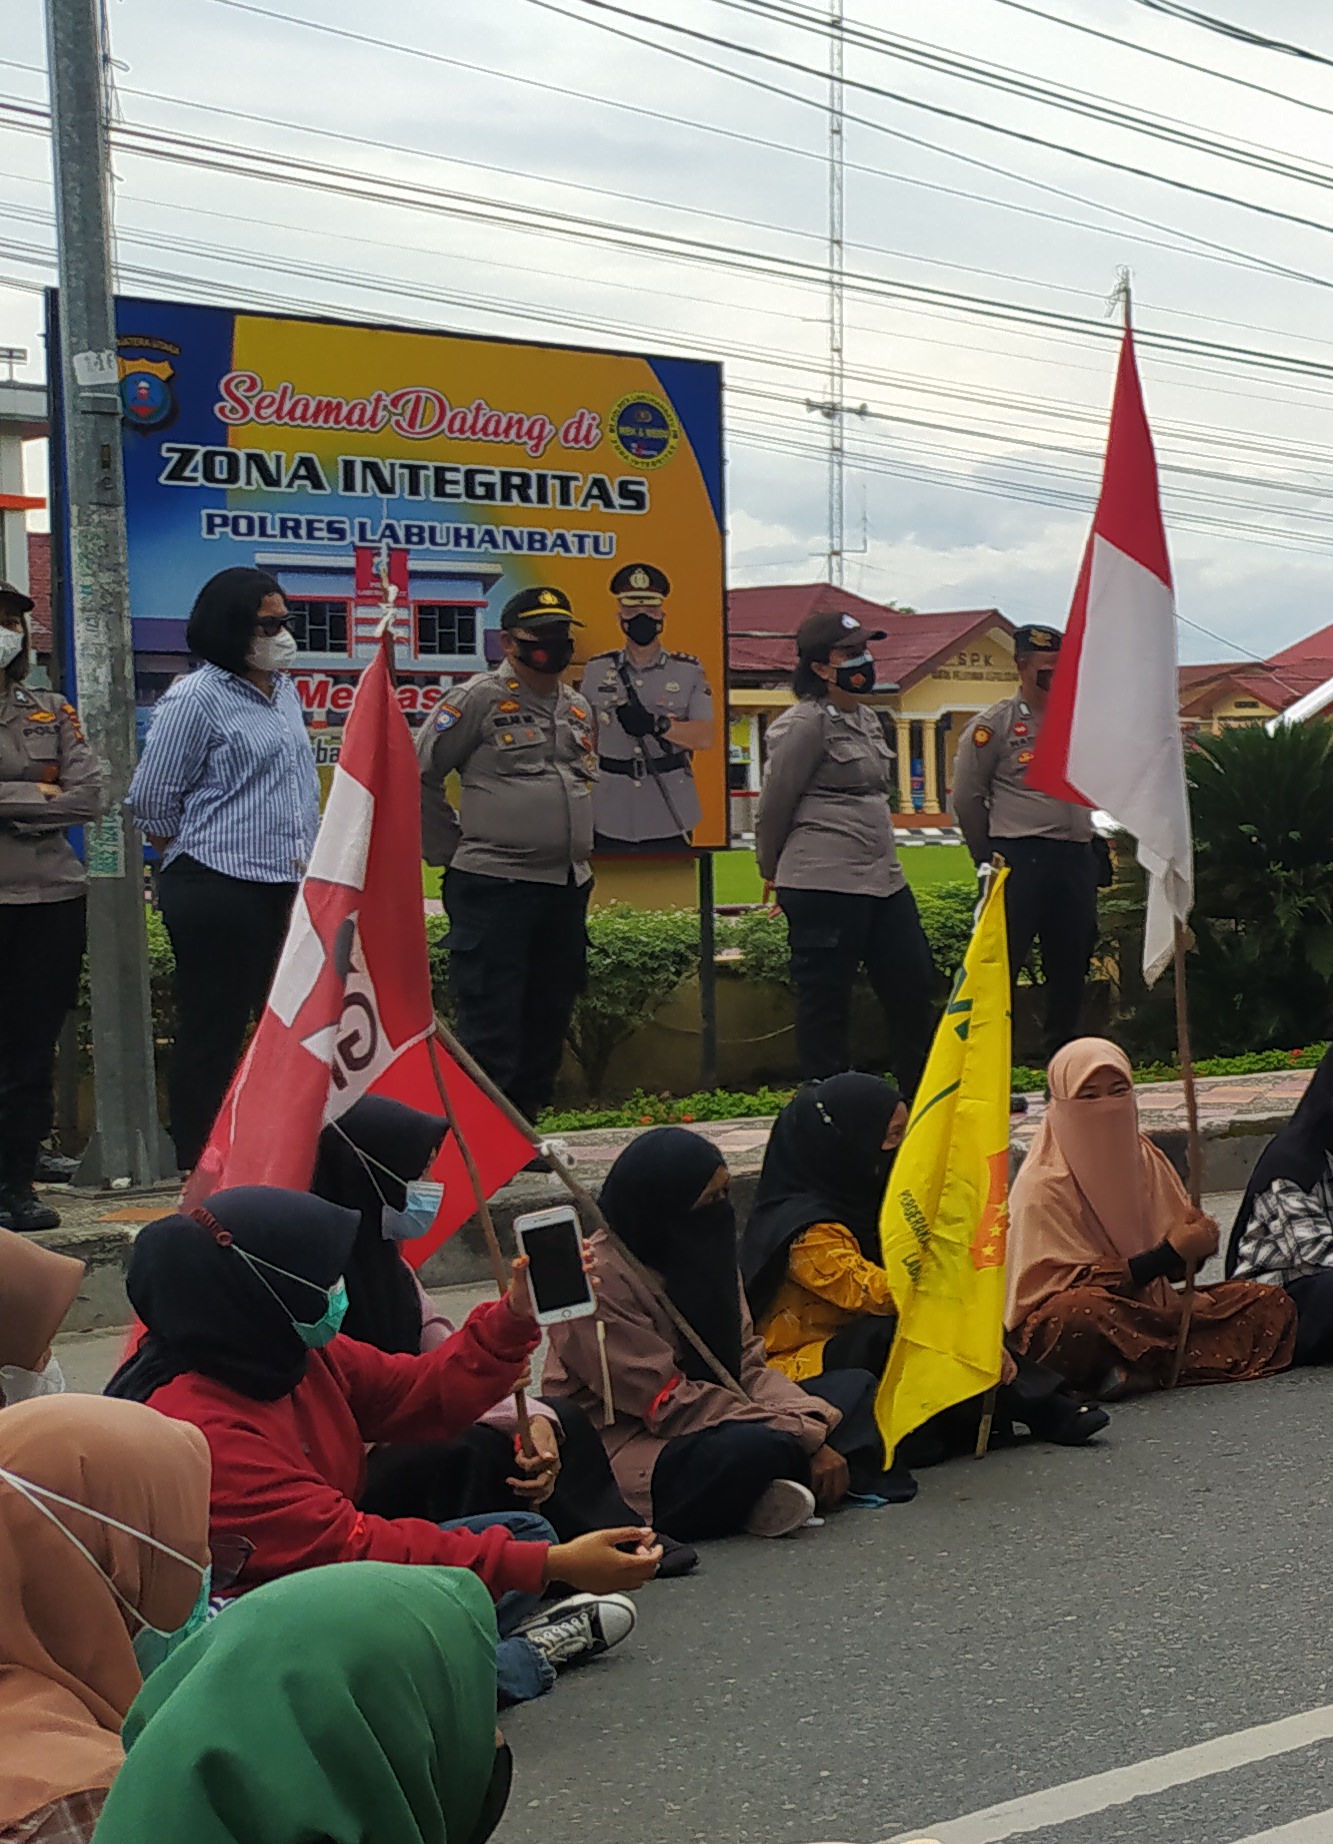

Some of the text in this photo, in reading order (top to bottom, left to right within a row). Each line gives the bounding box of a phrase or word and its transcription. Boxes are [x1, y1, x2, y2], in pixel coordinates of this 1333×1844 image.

[217, 373, 600, 455] Selamat Datang di
[163, 446, 647, 511] ZONA INTEGRITAS
[204, 512, 614, 556] POLRES LABUHANBATU
